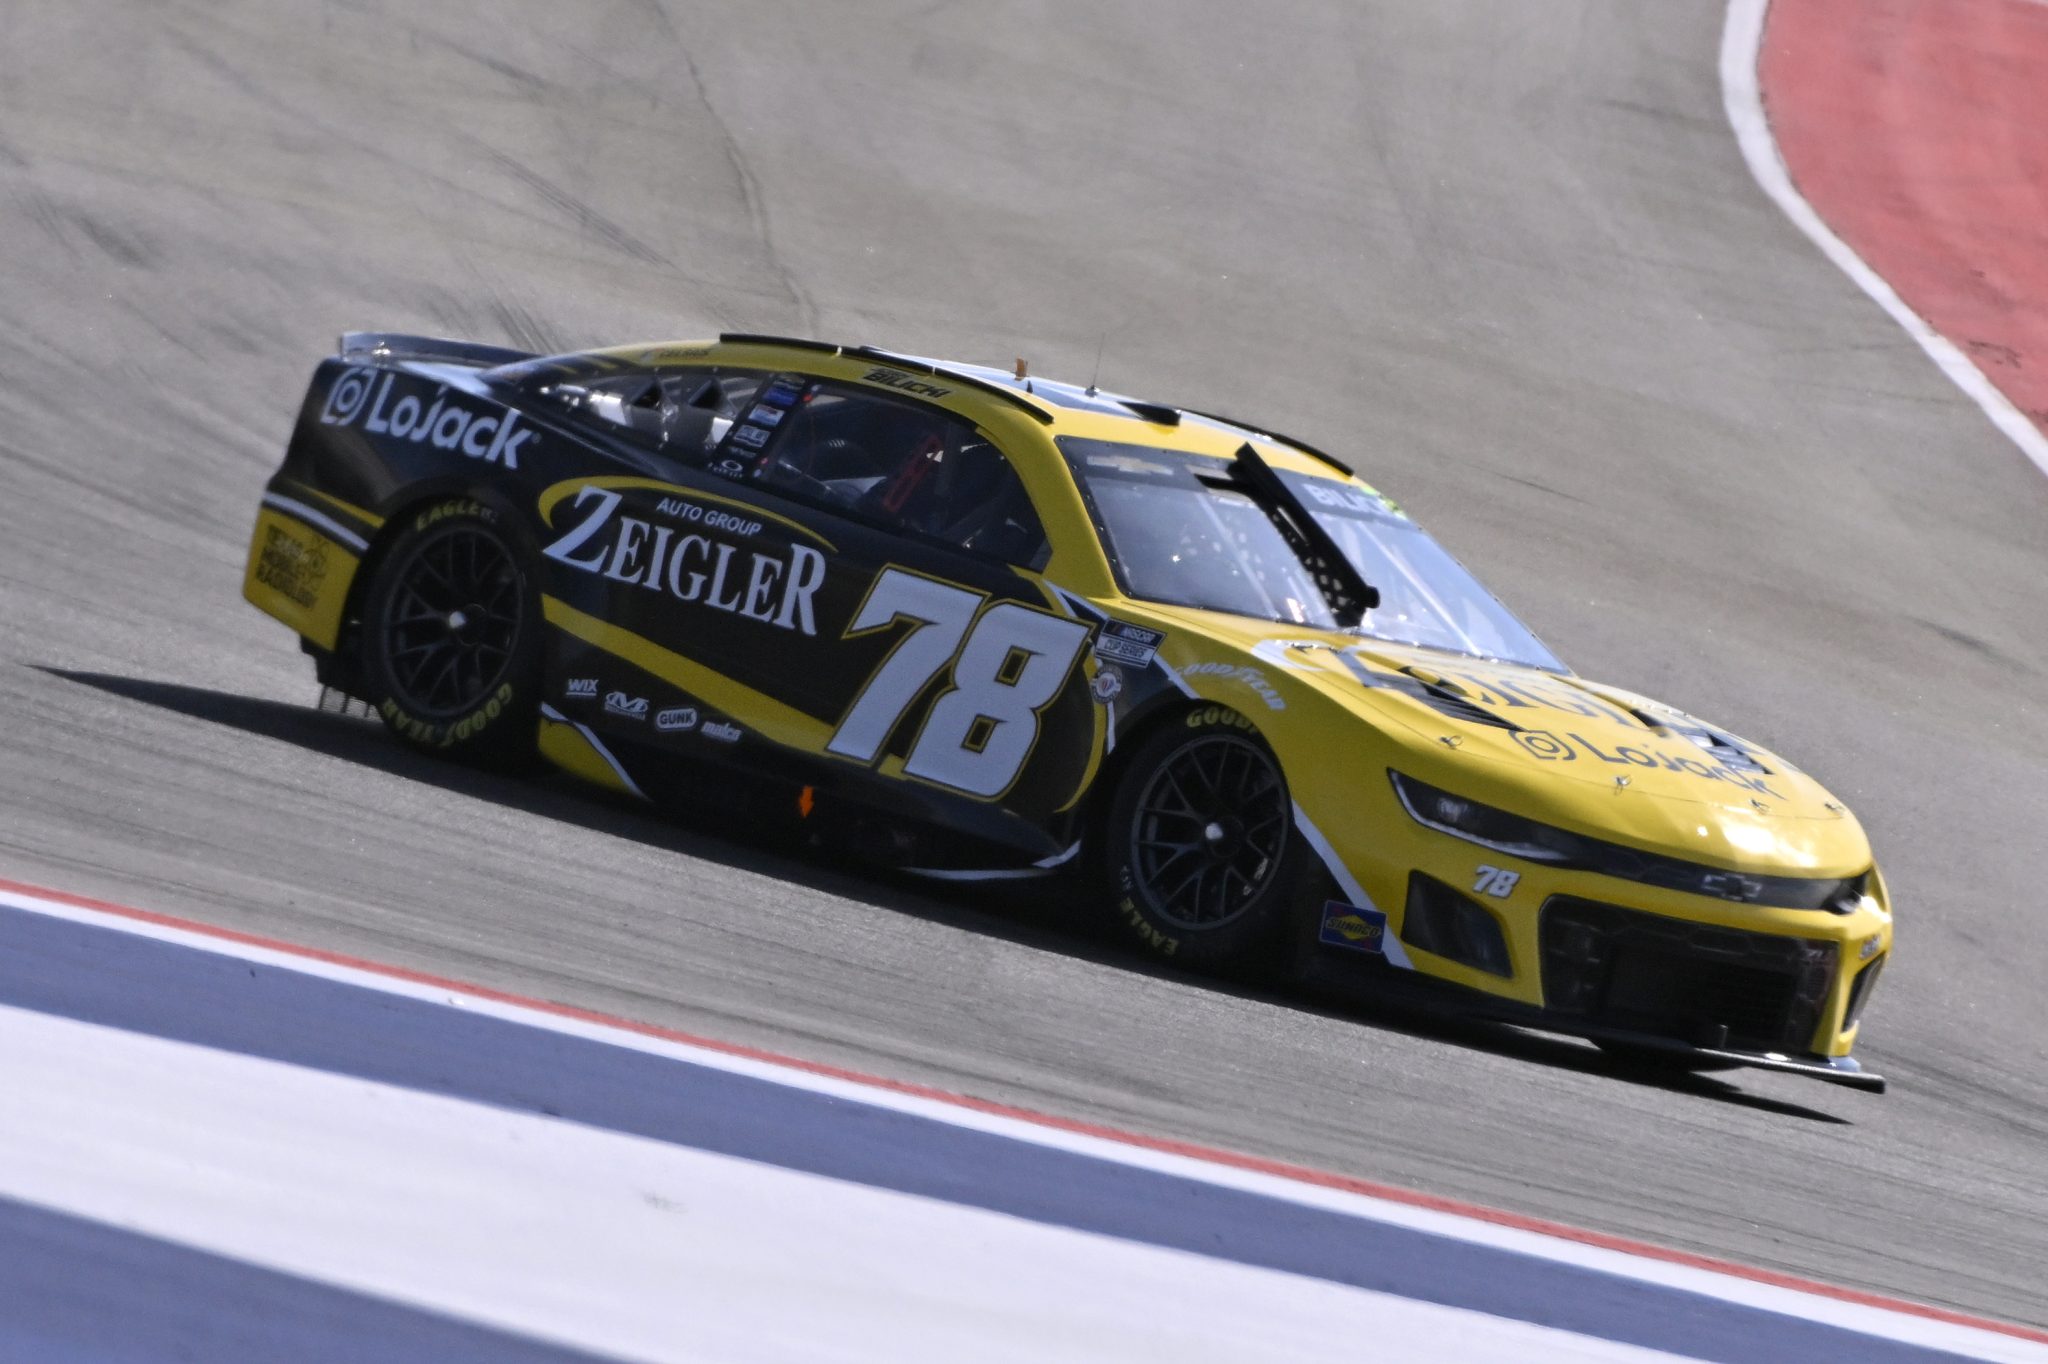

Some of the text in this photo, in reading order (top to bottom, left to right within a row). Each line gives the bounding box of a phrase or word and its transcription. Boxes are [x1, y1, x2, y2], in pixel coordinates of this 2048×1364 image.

[656, 497, 763, 536] AUTO GROUP
[542, 484, 827, 637] ZEIGLER
[567, 679, 599, 692] WIX
[825, 563, 1097, 801] 78
[659, 711, 694, 726] GUNK
[1472, 864, 1521, 898] 78
[1328, 917, 1380, 937] SUNOCO
